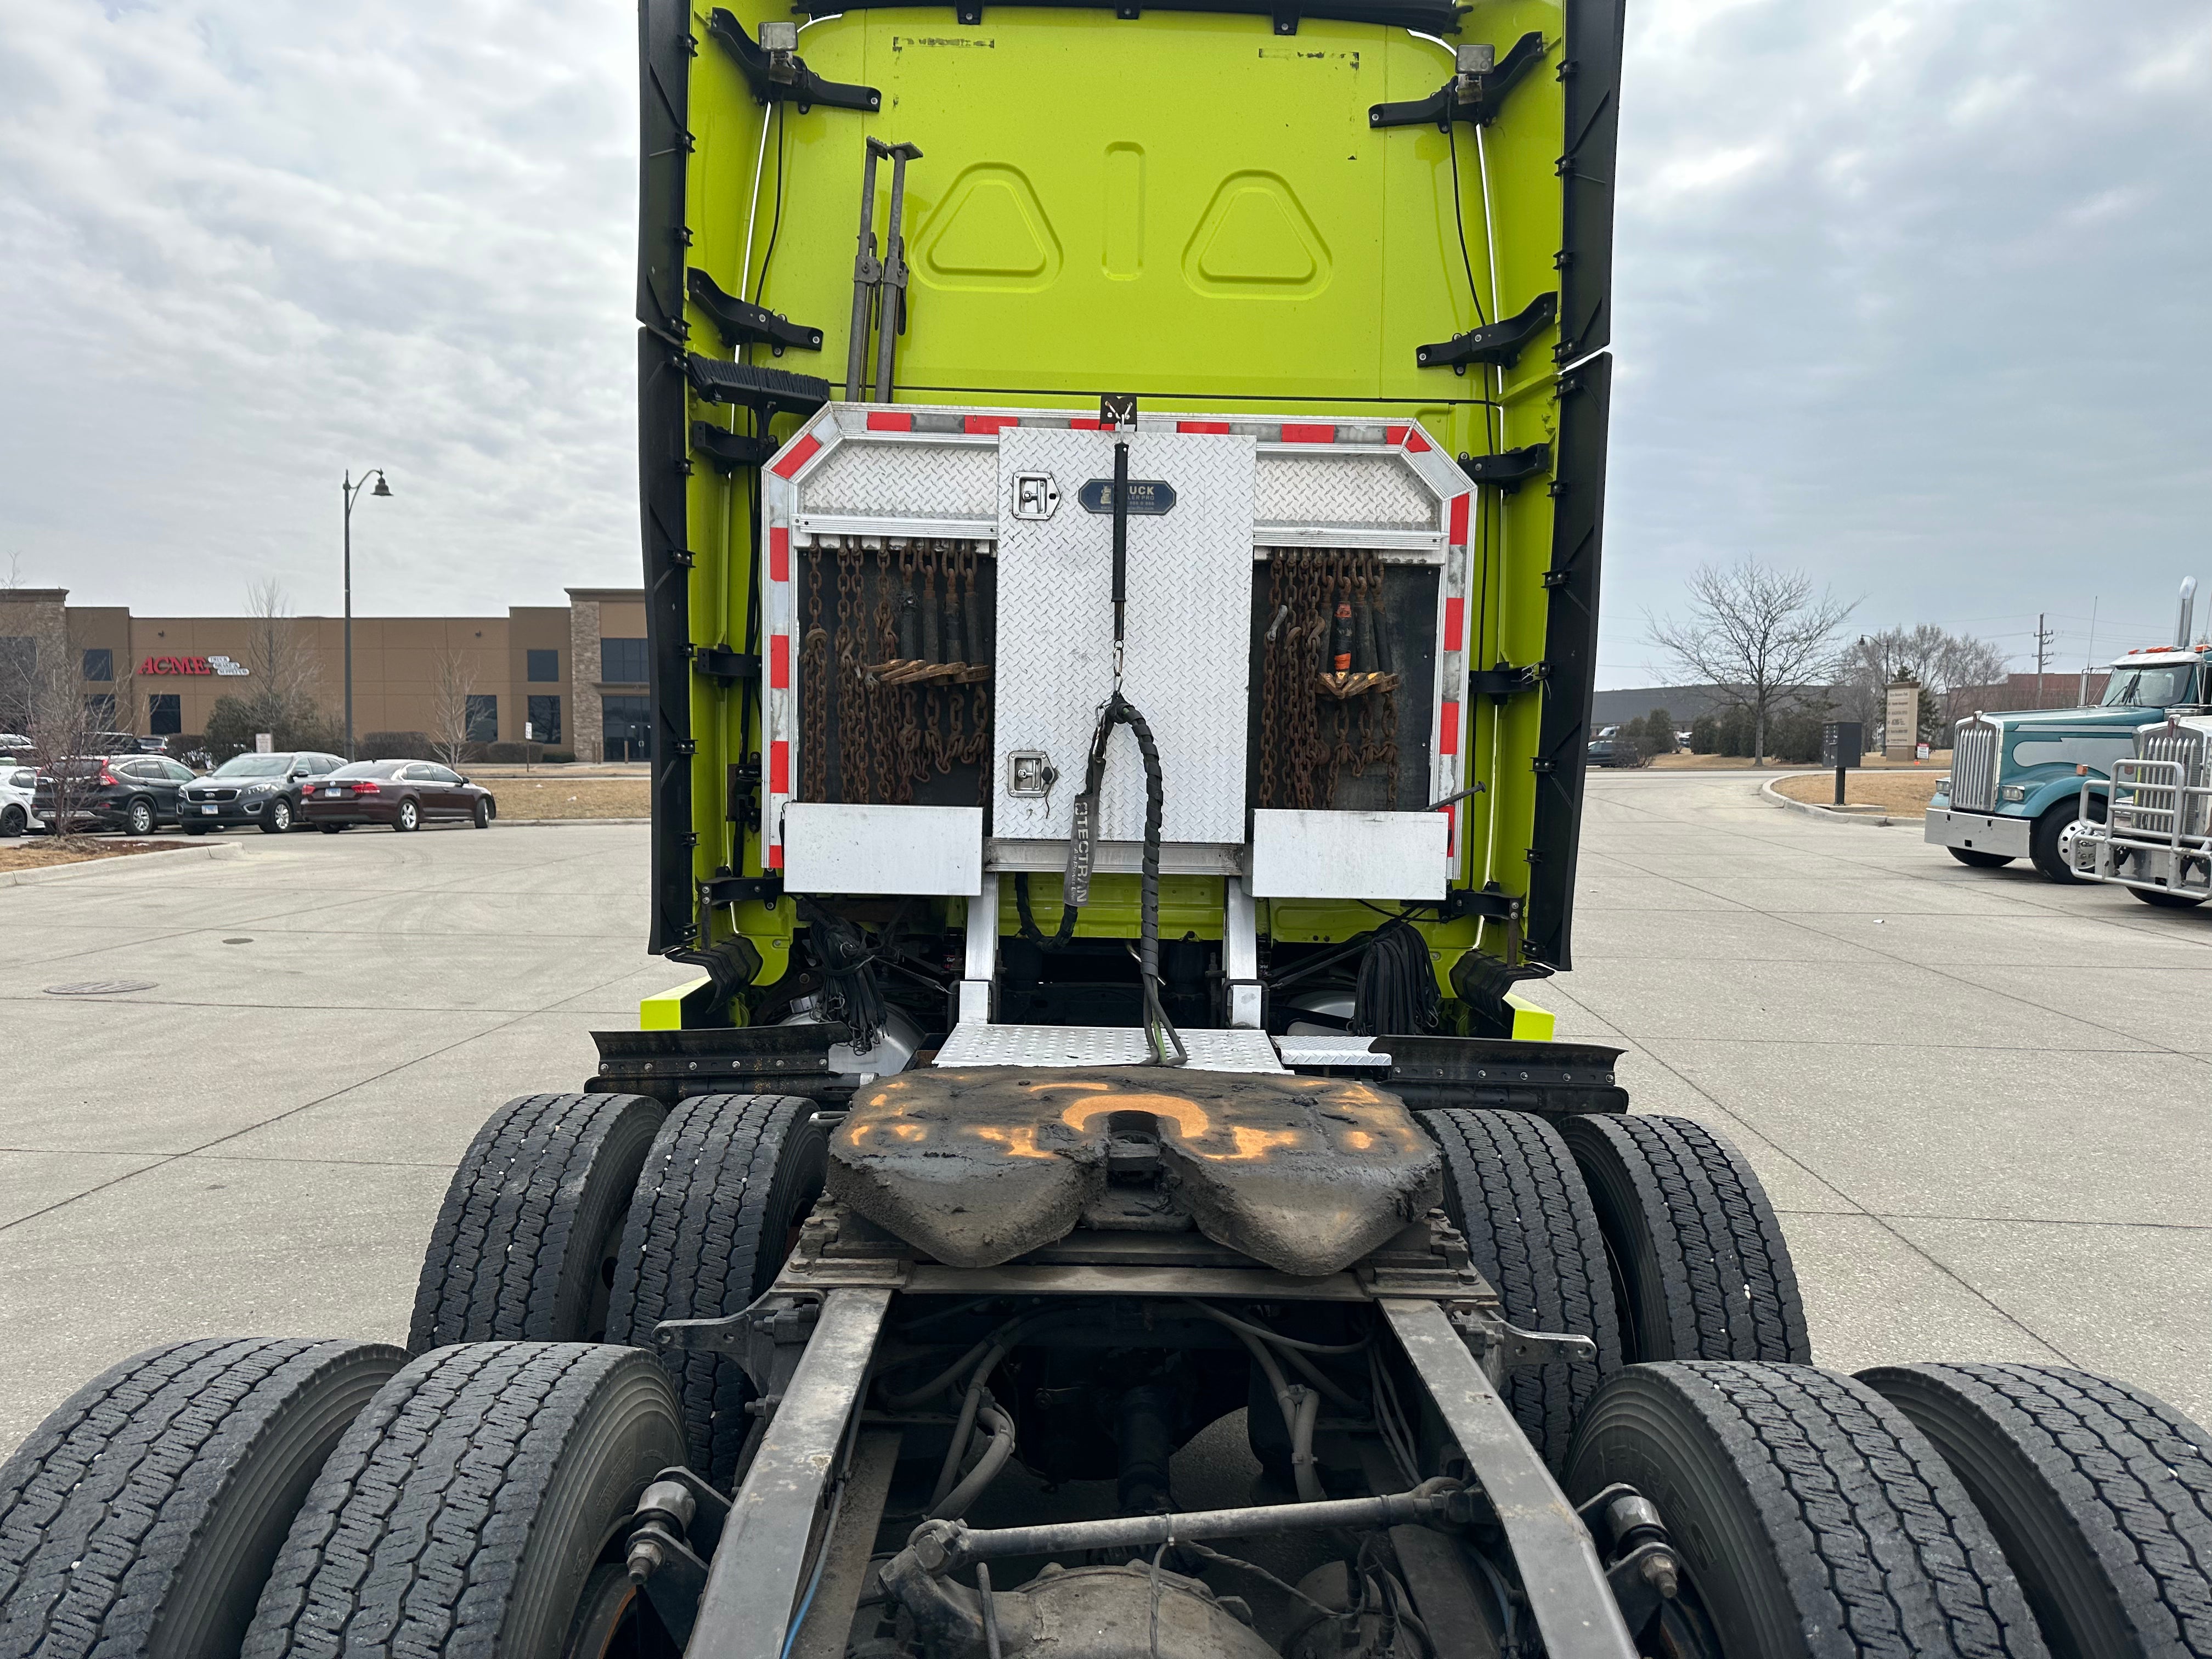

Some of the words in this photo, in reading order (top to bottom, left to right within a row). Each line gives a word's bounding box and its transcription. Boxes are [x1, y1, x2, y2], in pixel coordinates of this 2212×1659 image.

[1127, 486, 1155, 495] UCK
[137, 656, 211, 674] ACME
[1076, 816, 1089, 902] TECTRAN
